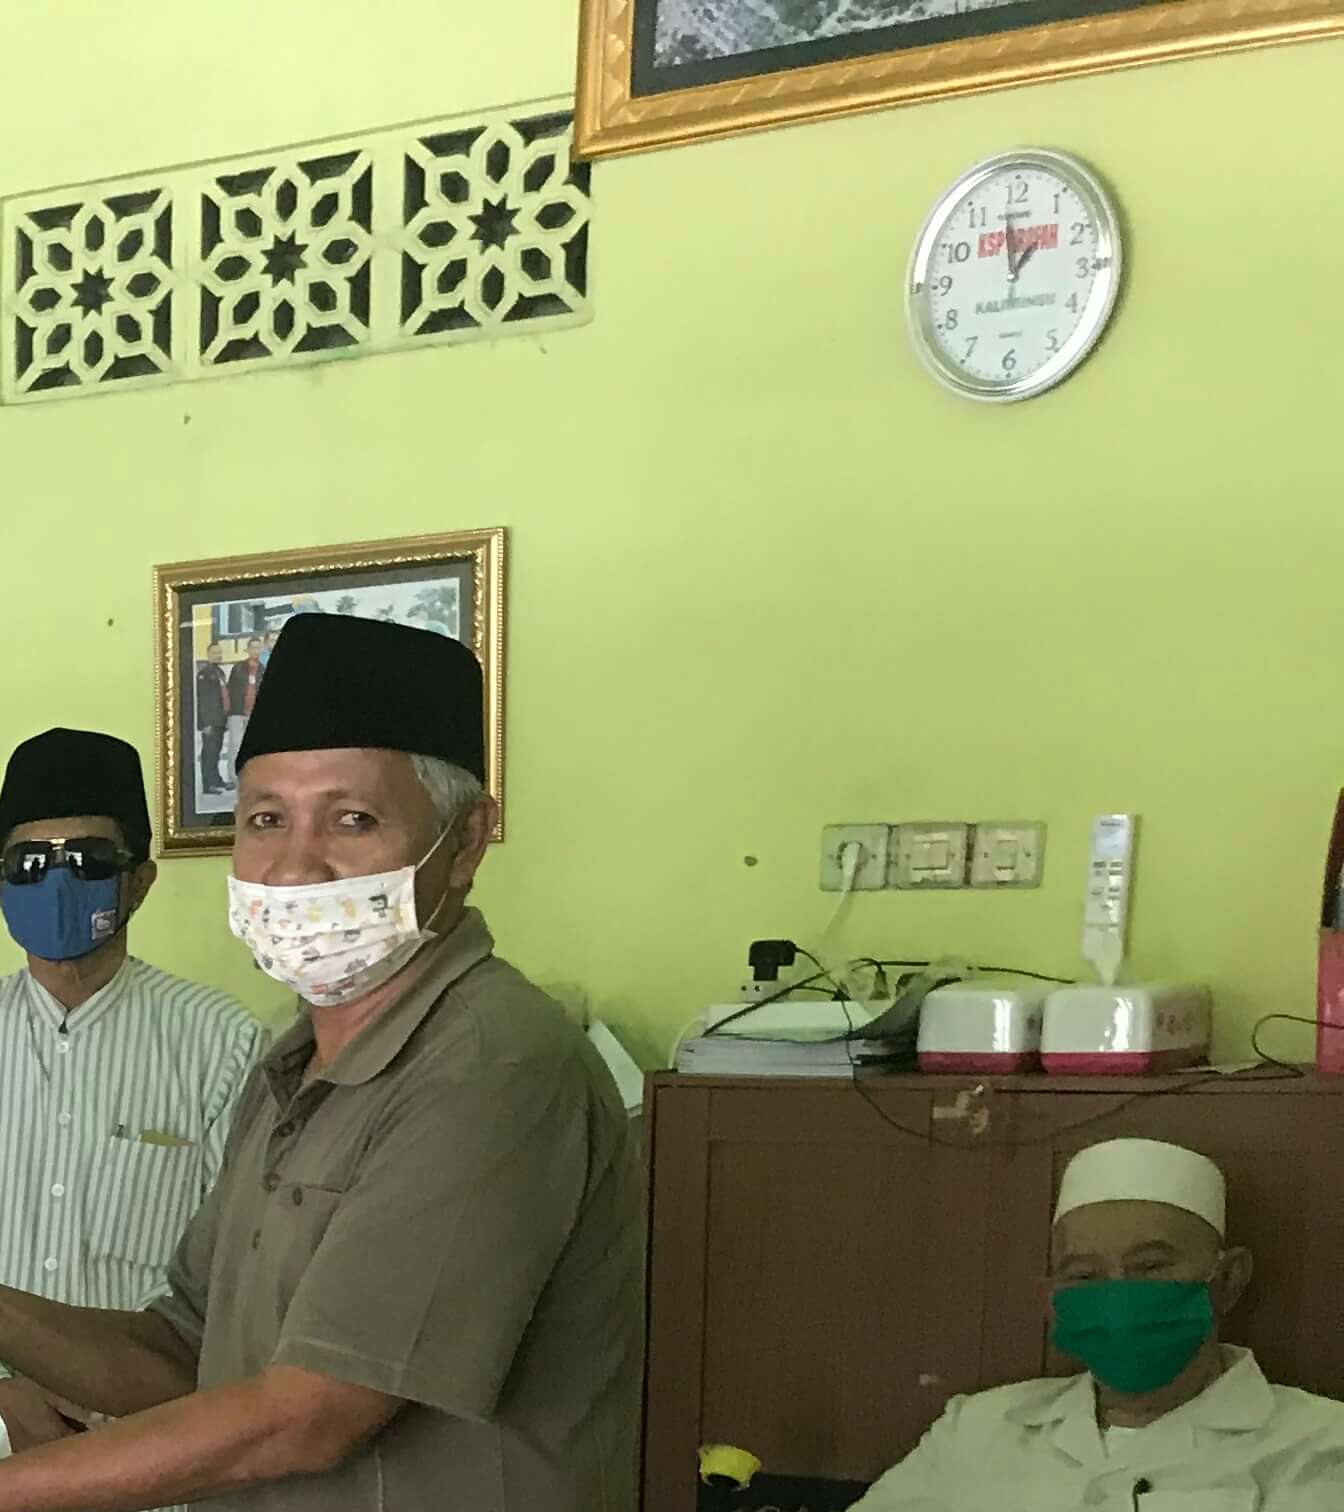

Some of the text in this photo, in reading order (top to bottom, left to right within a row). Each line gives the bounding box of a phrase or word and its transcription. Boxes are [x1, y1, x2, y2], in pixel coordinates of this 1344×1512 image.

[1005, 181, 1029, 205] 12
[1053, 193, 1060, 214] 1
[967, 206, 988, 229] 11
[1069, 222, 1085, 246] 2
[946, 242, 971, 264] 10
[1074, 257, 1089, 279] 3
[938, 276, 953, 297] 9
[1064, 292, 1078, 314] 4
[944, 308, 959, 331] 8
[964, 336, 979, 359] 7
[1044, 329, 1059, 351] 5
[1001, 348, 1017, 372] 6
